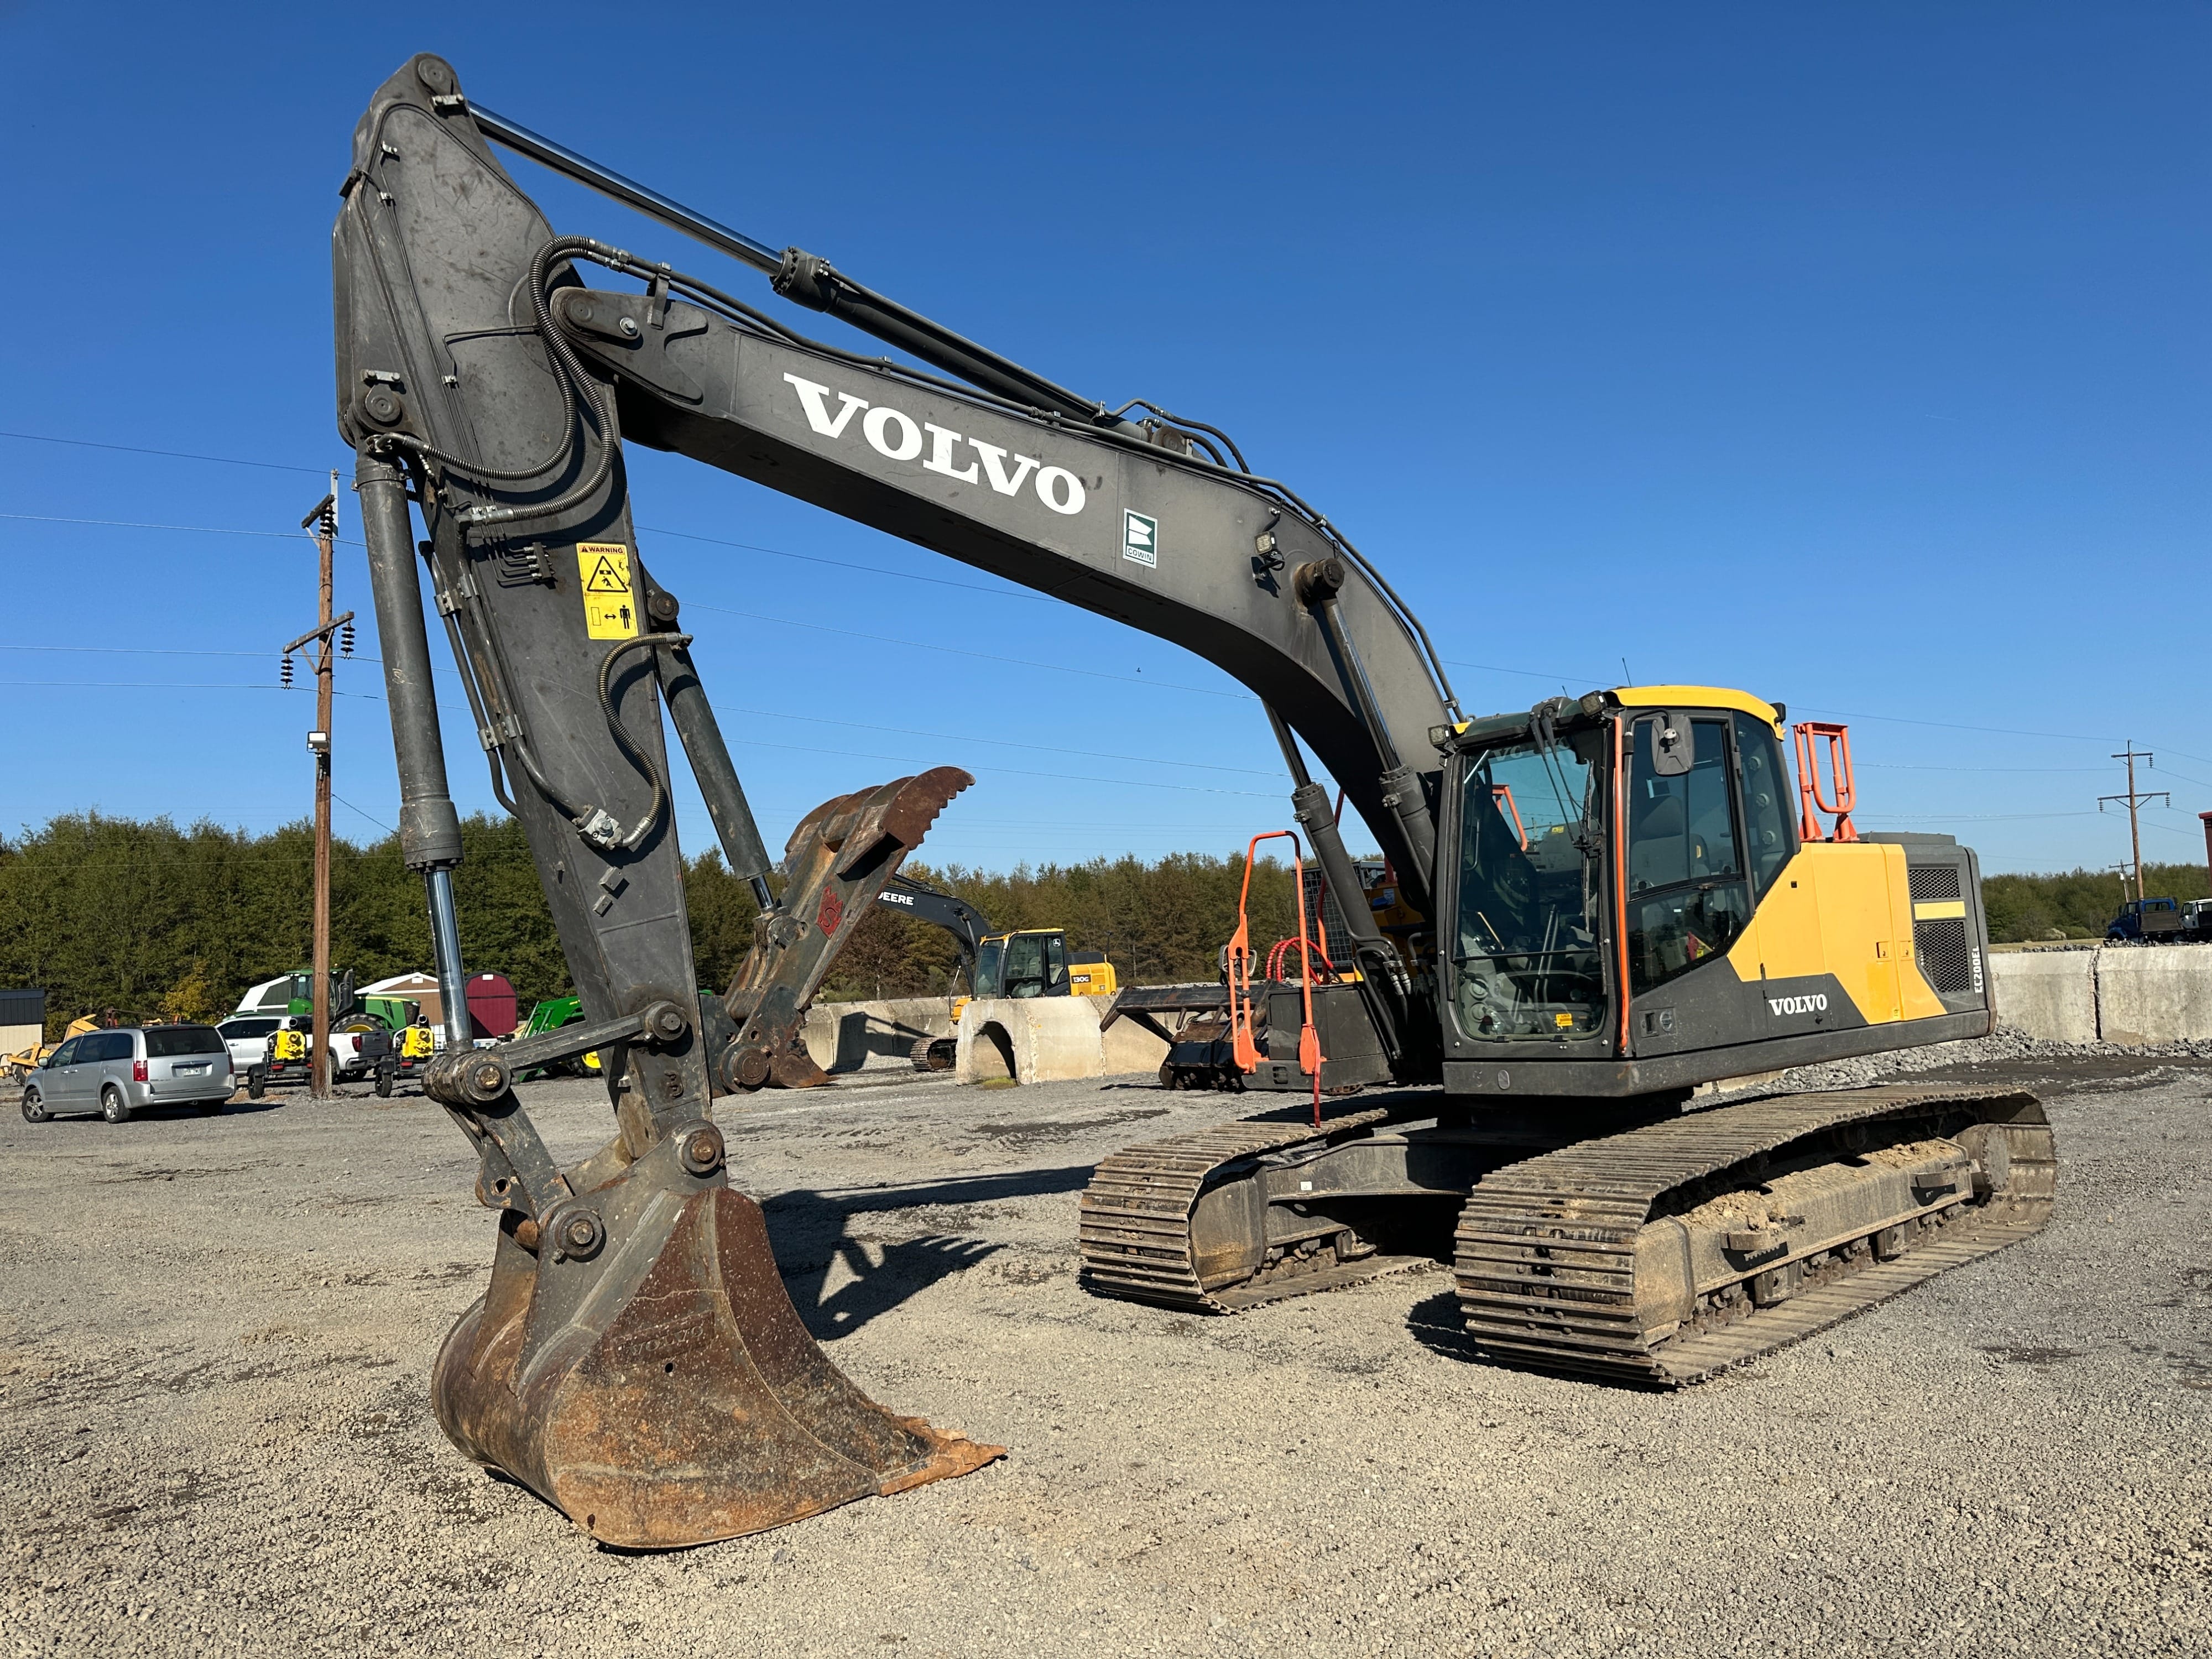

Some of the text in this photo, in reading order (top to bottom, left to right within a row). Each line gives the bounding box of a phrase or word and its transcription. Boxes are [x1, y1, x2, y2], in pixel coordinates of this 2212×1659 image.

[784, 372, 1086, 515] VOLVO
[1128, 548, 1152, 561] COWIN
[1971, 946, 1983, 993] EC200EL
[1768, 994, 1827, 1016] VOLVO
